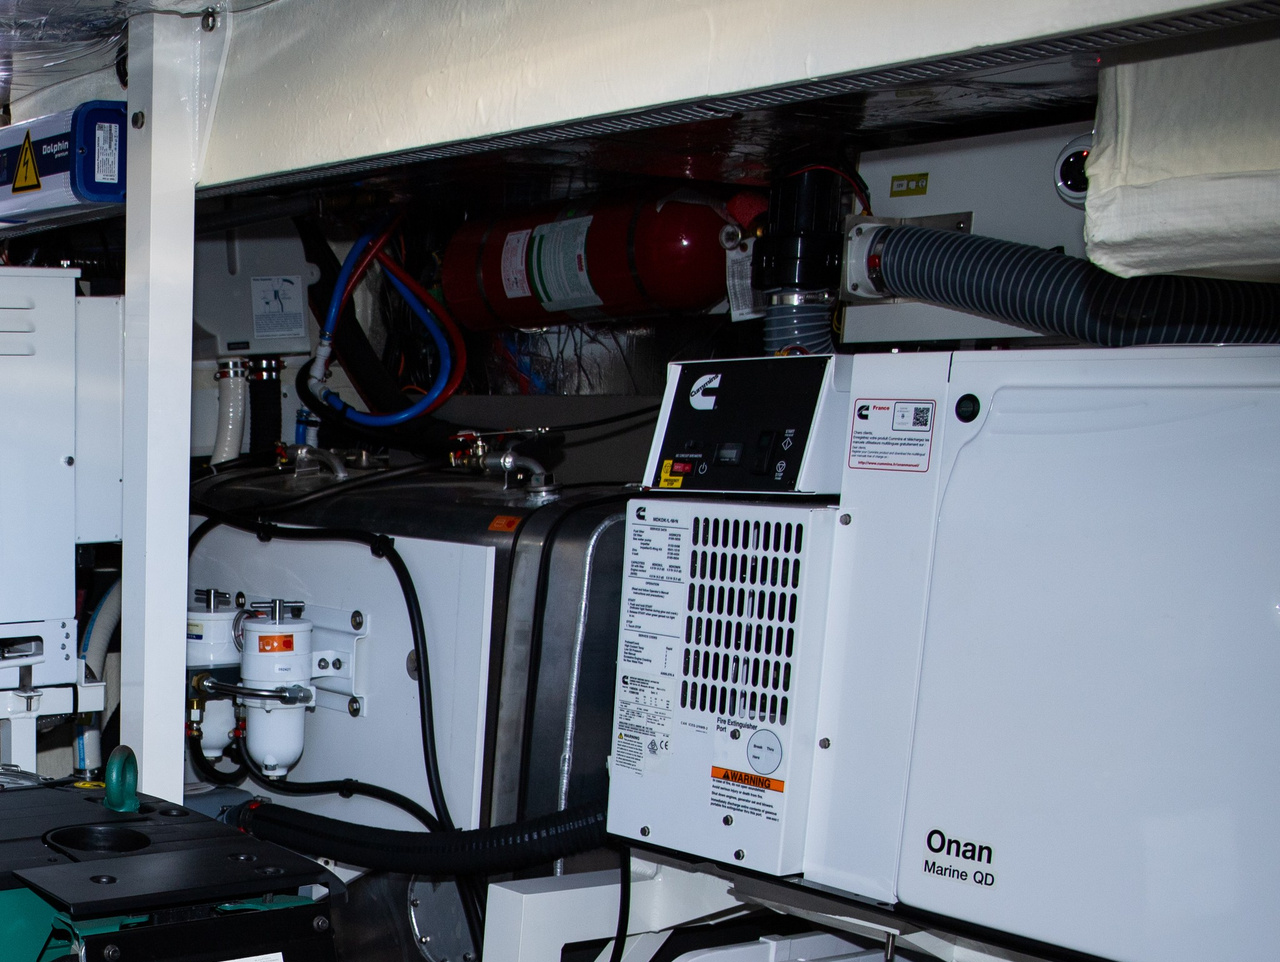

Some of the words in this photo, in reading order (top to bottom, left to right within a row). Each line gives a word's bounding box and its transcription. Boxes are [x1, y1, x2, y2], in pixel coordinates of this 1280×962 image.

[42, 141, 69, 155] Dolphin
[690, 374, 719, 397] Cummins
[717, 717, 726, 725] Fire
[727, 719, 758, 730] Extinguisher
[731, 770, 771, 788] WARNING
[927, 829, 993, 864] Onan
[923, 859, 968, 880] Marine
[973, 870, 994, 886] QD
